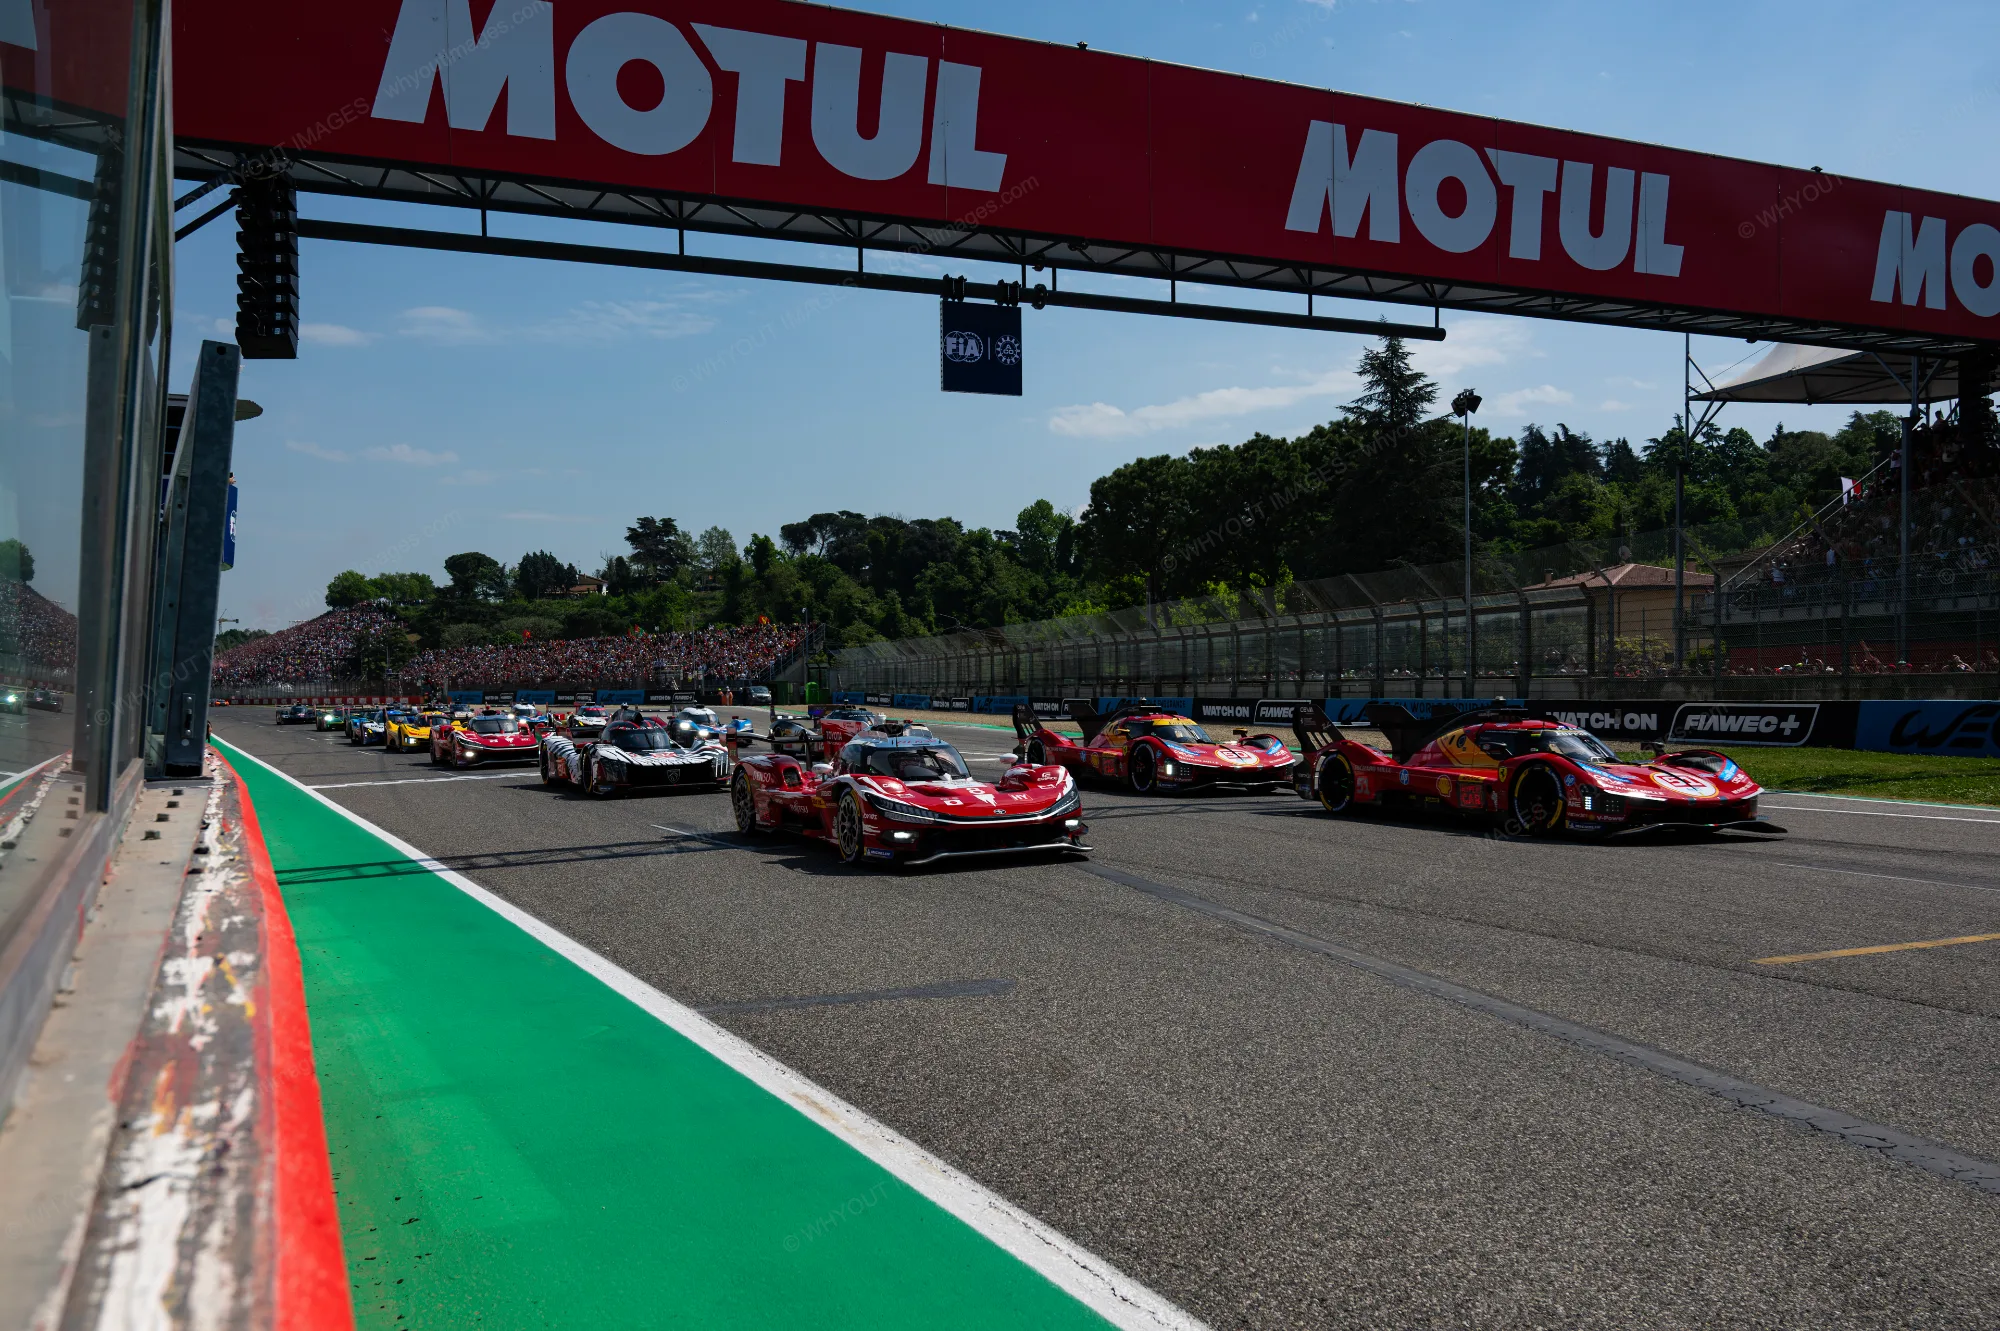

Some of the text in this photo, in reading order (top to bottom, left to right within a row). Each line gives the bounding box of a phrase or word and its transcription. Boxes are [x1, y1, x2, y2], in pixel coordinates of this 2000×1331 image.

[371, 0, 1007, 192] MOTUL
[1285, 120, 1685, 277] MOTUL
[1202, 705, 1250, 718] WATCH ON
[1623, 713, 1658, 731] ON
[1684, 713, 1801, 736] FIAWEC+
[1889, 703, 2000, 748] WE
[1356, 775, 1371, 795] 51
[1461, 794, 1482, 806] CAR
